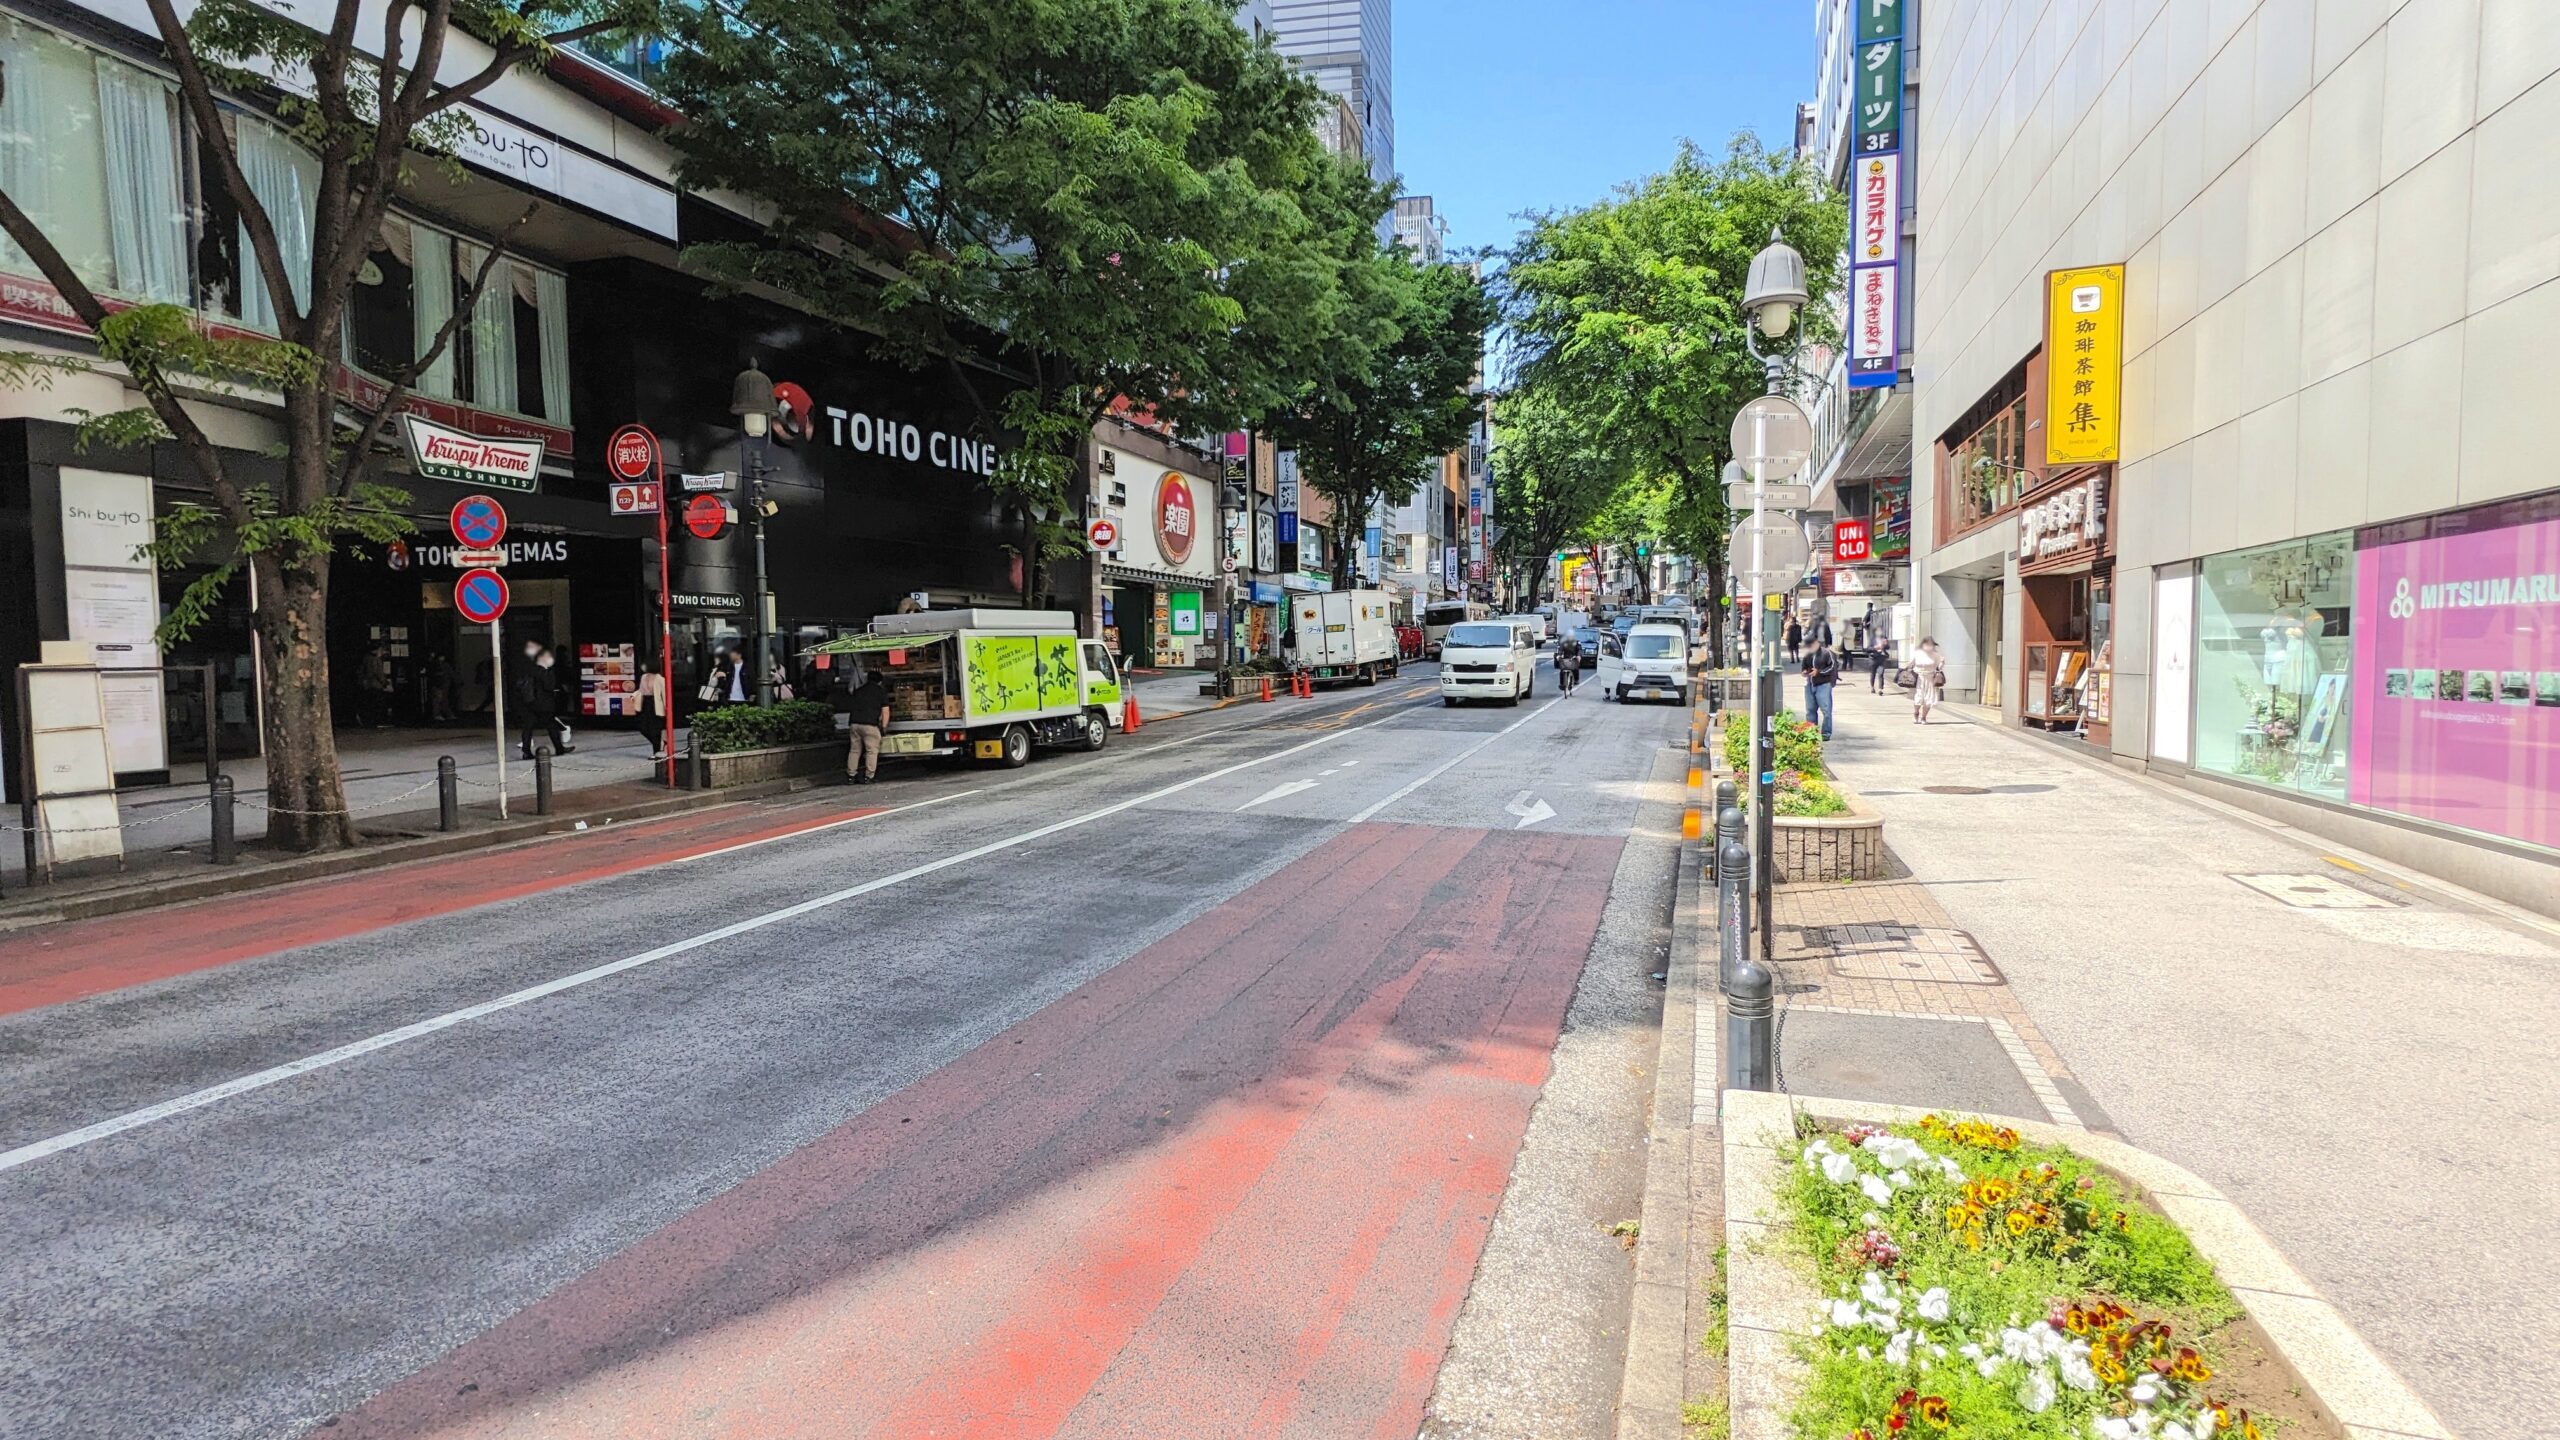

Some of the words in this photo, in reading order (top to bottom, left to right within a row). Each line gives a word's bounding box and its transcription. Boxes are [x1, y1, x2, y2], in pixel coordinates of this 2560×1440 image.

[1866, 133, 1890, 151] 3F
[1866, 175, 1886, 246] カラオケ
[1865, 271, 1883, 354] まねきねこ
[1862, 358, 1883, 371] 4F
[826, 405, 921, 462] TOHO
[425, 434, 482, 469] Krispy
[480, 444, 531, 473] Kreme
[618, 445, 648, 464] 消火栓
[427, 465, 529, 487] DOUGHNUTS
[1840, 526, 1863, 541] UNI
[1840, 541, 1865, 558] QLO
[1225, 558, 1234, 570] 5
[672, 595, 699, 605] TOHO
[700, 596, 741, 607] CINEMAS
